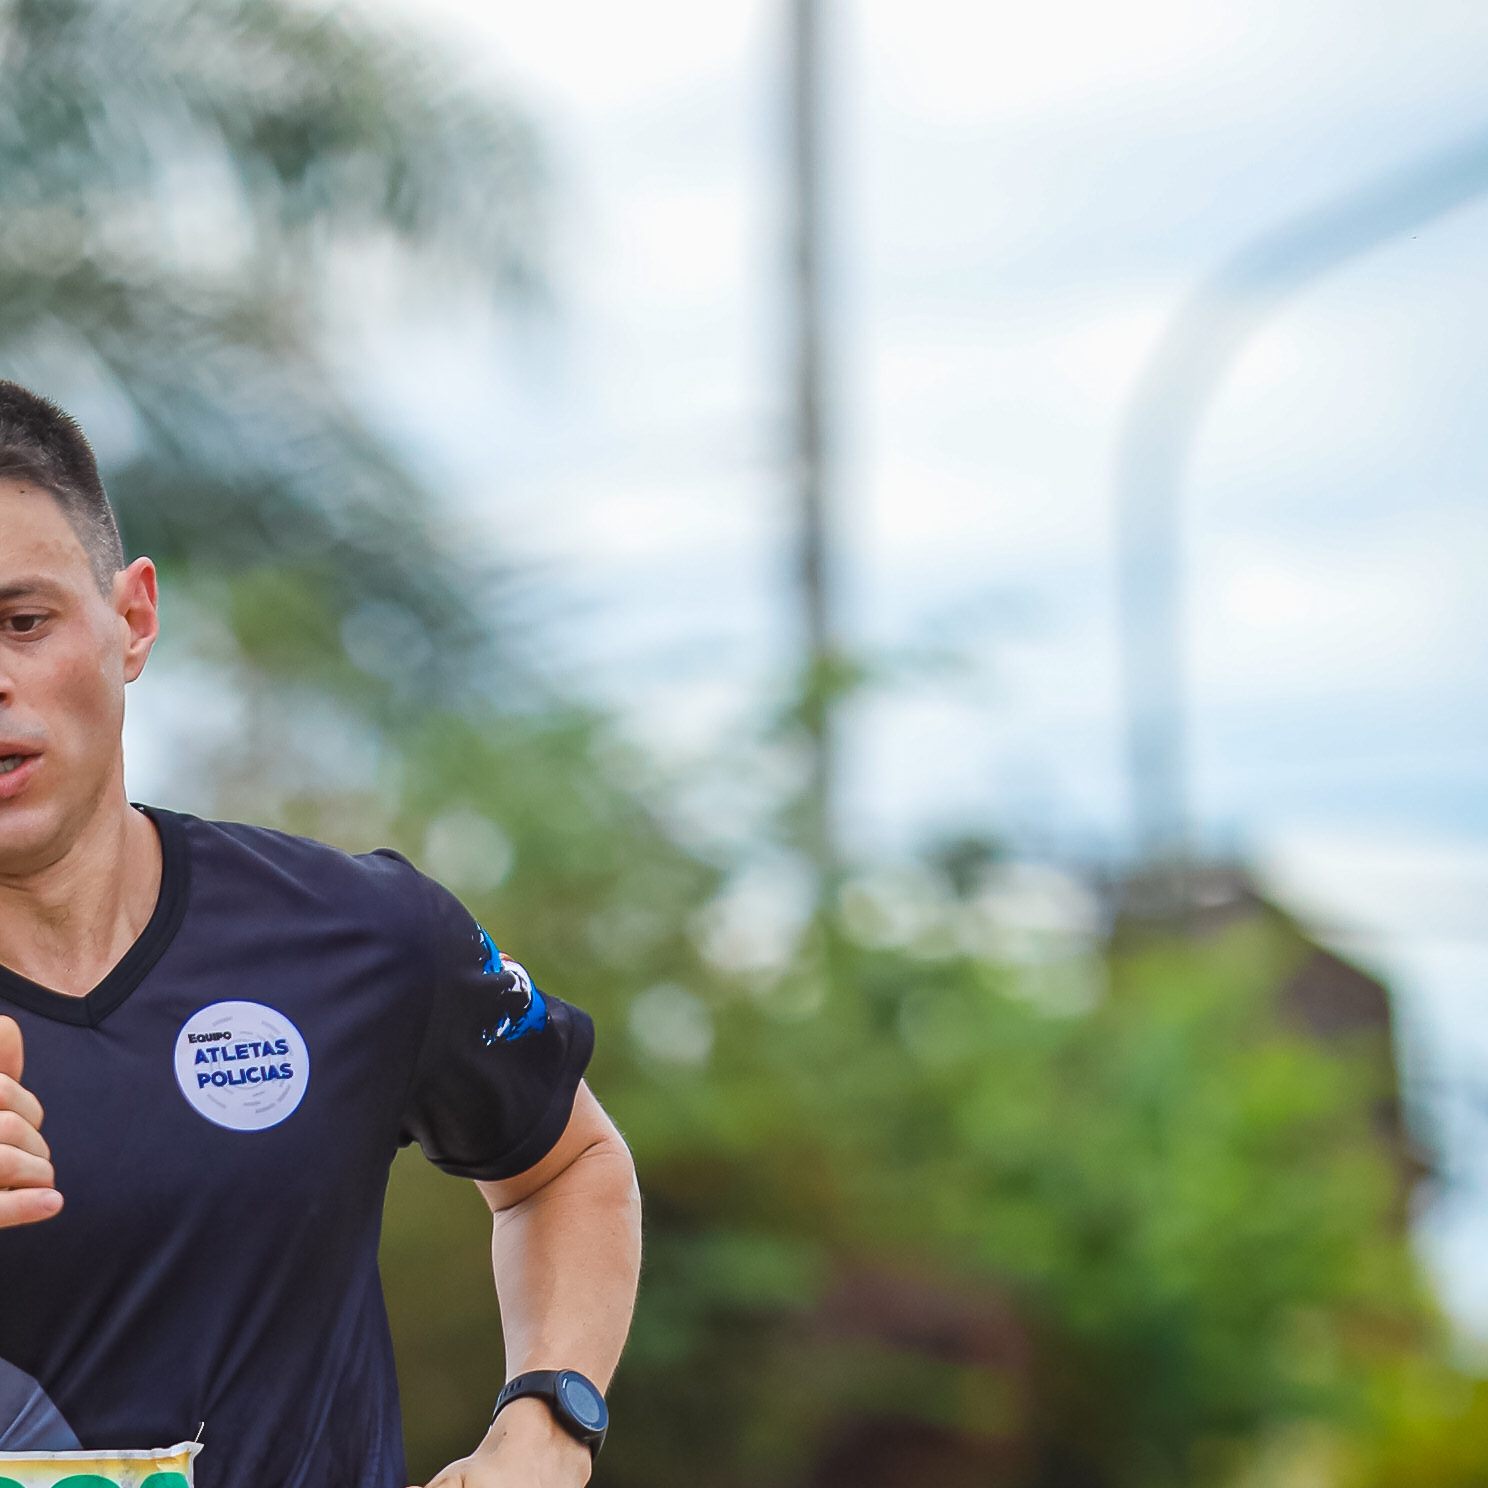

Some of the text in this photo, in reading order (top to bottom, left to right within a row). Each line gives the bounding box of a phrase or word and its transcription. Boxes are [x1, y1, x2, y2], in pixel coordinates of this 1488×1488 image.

[188, 1031, 232, 1043] EQUIPO
[195, 1039, 289, 1065] ATLETAS
[197, 1063, 294, 1089] POLICIAS
